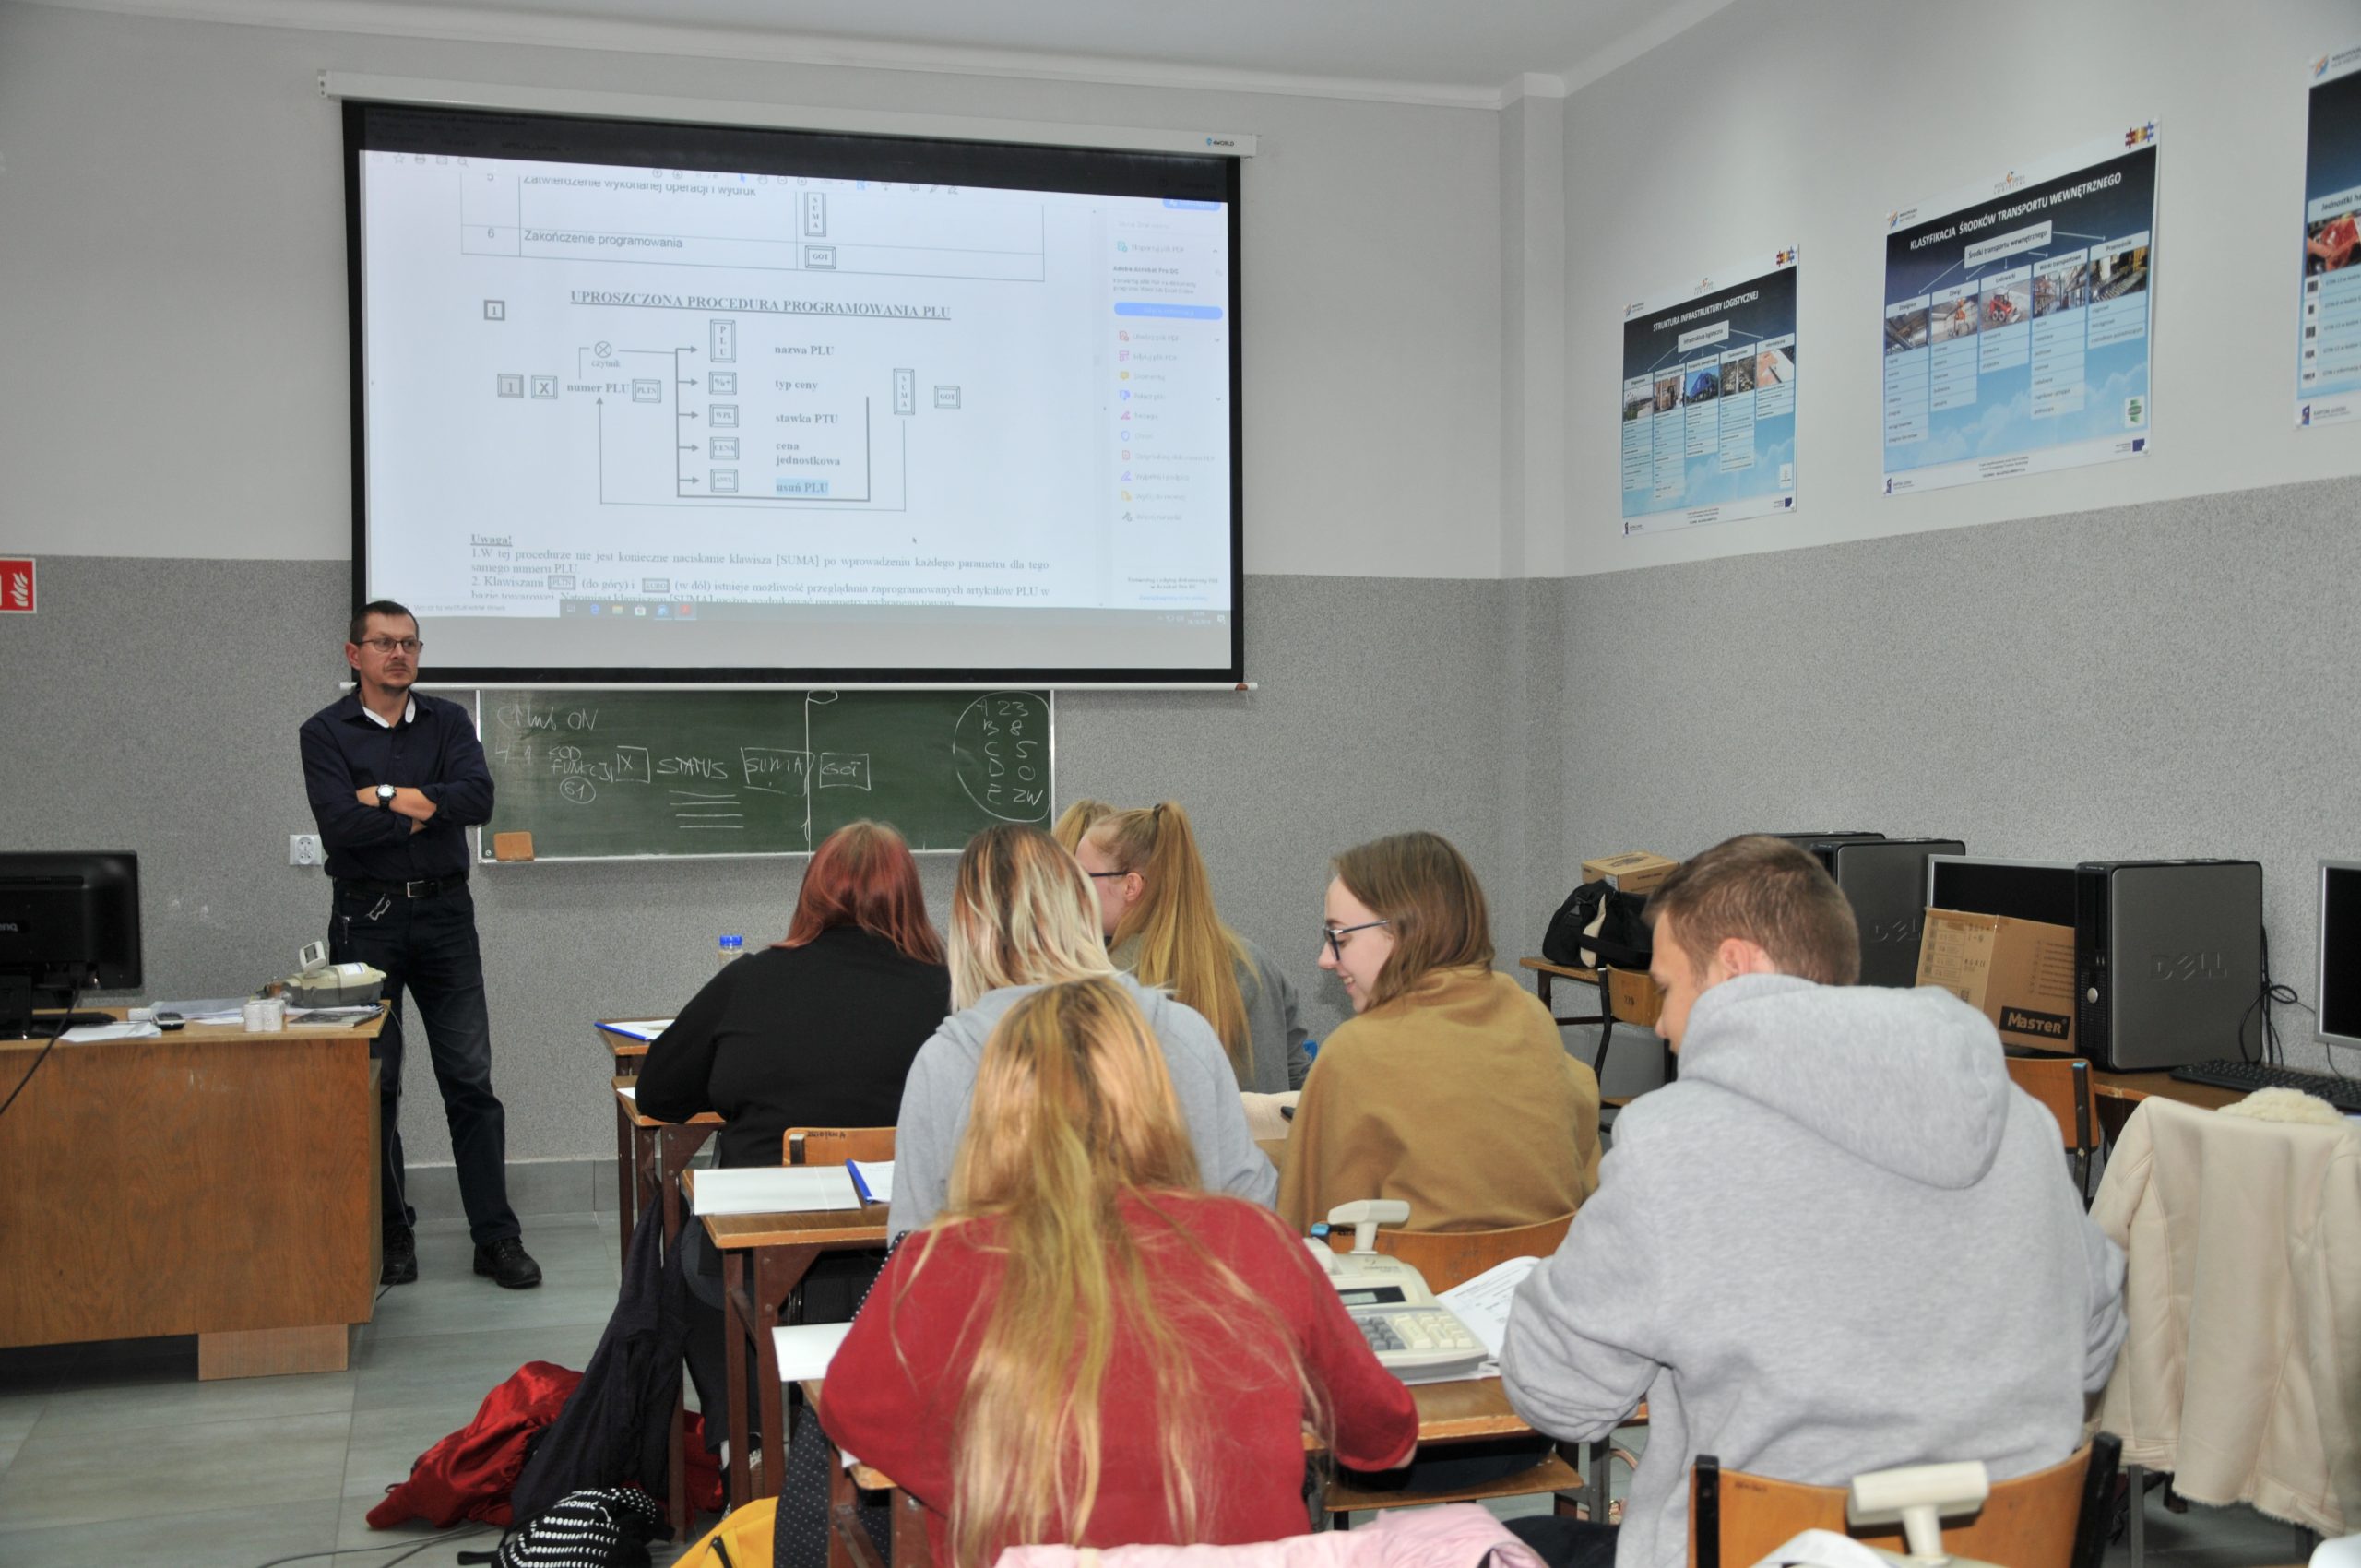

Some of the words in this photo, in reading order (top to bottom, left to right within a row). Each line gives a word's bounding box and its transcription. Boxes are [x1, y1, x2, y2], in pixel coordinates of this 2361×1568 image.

[1910, 226, 1956, 250] KLASYFIKACJA
[1958, 214, 1996, 235] ŚRODKÓW
[1997, 197, 2048, 222] TRANSPORTU
[2049, 172, 2122, 206] WEWNĘTRZNEGO
[2321, 195, 2353, 212] Jednostki
[487, 229, 494, 240] 6
[523, 229, 595, 245] Zakończenie
[598, 234, 683, 250] programowania
[1984, 241, 2009, 256] transportu
[2011, 231, 2047, 248] wewnętrznego
[491, 305, 498, 316] 1
[571, 290, 684, 308] UPROSZCZONA
[687, 295, 780, 312] PROCEDURA
[783, 300, 919, 317] PROGRAMOWANIA
[922, 305, 951, 320] PLU
[1653, 315, 1680, 332] STRUKTURA
[1680, 302, 1723, 323] INFRASTRUKTURY
[1723, 291, 1759, 309] LOGISTYCZNEJ
[774, 345, 808, 355] nazwa
[810, 345, 835, 357] PLU
[591, 358, 622, 369] czytnik
[539, 382, 550, 395] X
[566, 383, 602, 394] numer
[605, 383, 630, 395] PLU
[775, 380, 792, 391] typ
[794, 381, 818, 392] ceny
[775, 412, 812, 423] stawka
[814, 413, 838, 424] PTU
[776, 442, 800, 451] cena
[775, 455, 841, 467] jednostkowa
[776, 481, 802, 493] usuń
[804, 481, 829, 493] PLU
[470, 533, 513, 546] Uwaga!
[516, 550, 571, 563] procedurze
[575, 552, 591, 561] nie
[596, 552, 613, 563] jest
[618, 552, 669, 564] konieczne
[673, 552, 725, 564] naciskanie
[730, 553, 772, 565] klawisza
[777, 554, 820, 568] [SUMA]
[823, 558, 837, 568] po
[841, 556, 910, 569] wprowadzeniu
[915, 556, 955, 570] każdego
[958, 559, 1006, 571] parametru
[1010, 558, 1025, 570] dla
[1028, 560, 1050, 572] tego
[484, 576, 544, 588] Klawiszami
[582, 578, 599, 589] (do
[602, 578, 629, 590] góry)
[714, 582, 750, 593] istnieje
[752, 582, 804, 593] możliwość
[807, 583, 868, 596] przeglądania
[871, 584, 963, 597] zaprogramowanych
[966, 586, 1014, 598] artykułów
[1016, 587, 1038, 597] PLU
[997, 699, 1029, 718] 23
[567, 708, 599, 731] ON
[1010, 720, 1024, 736] 8
[984, 742, 1000, 757] C
[656, 757, 729, 779] STATUS
[987, 759, 1005, 777] D
[986, 784, 1002, 806] E
[1872, 918, 1922, 942] DEL
[2151, 952, 2228, 981] DELL
